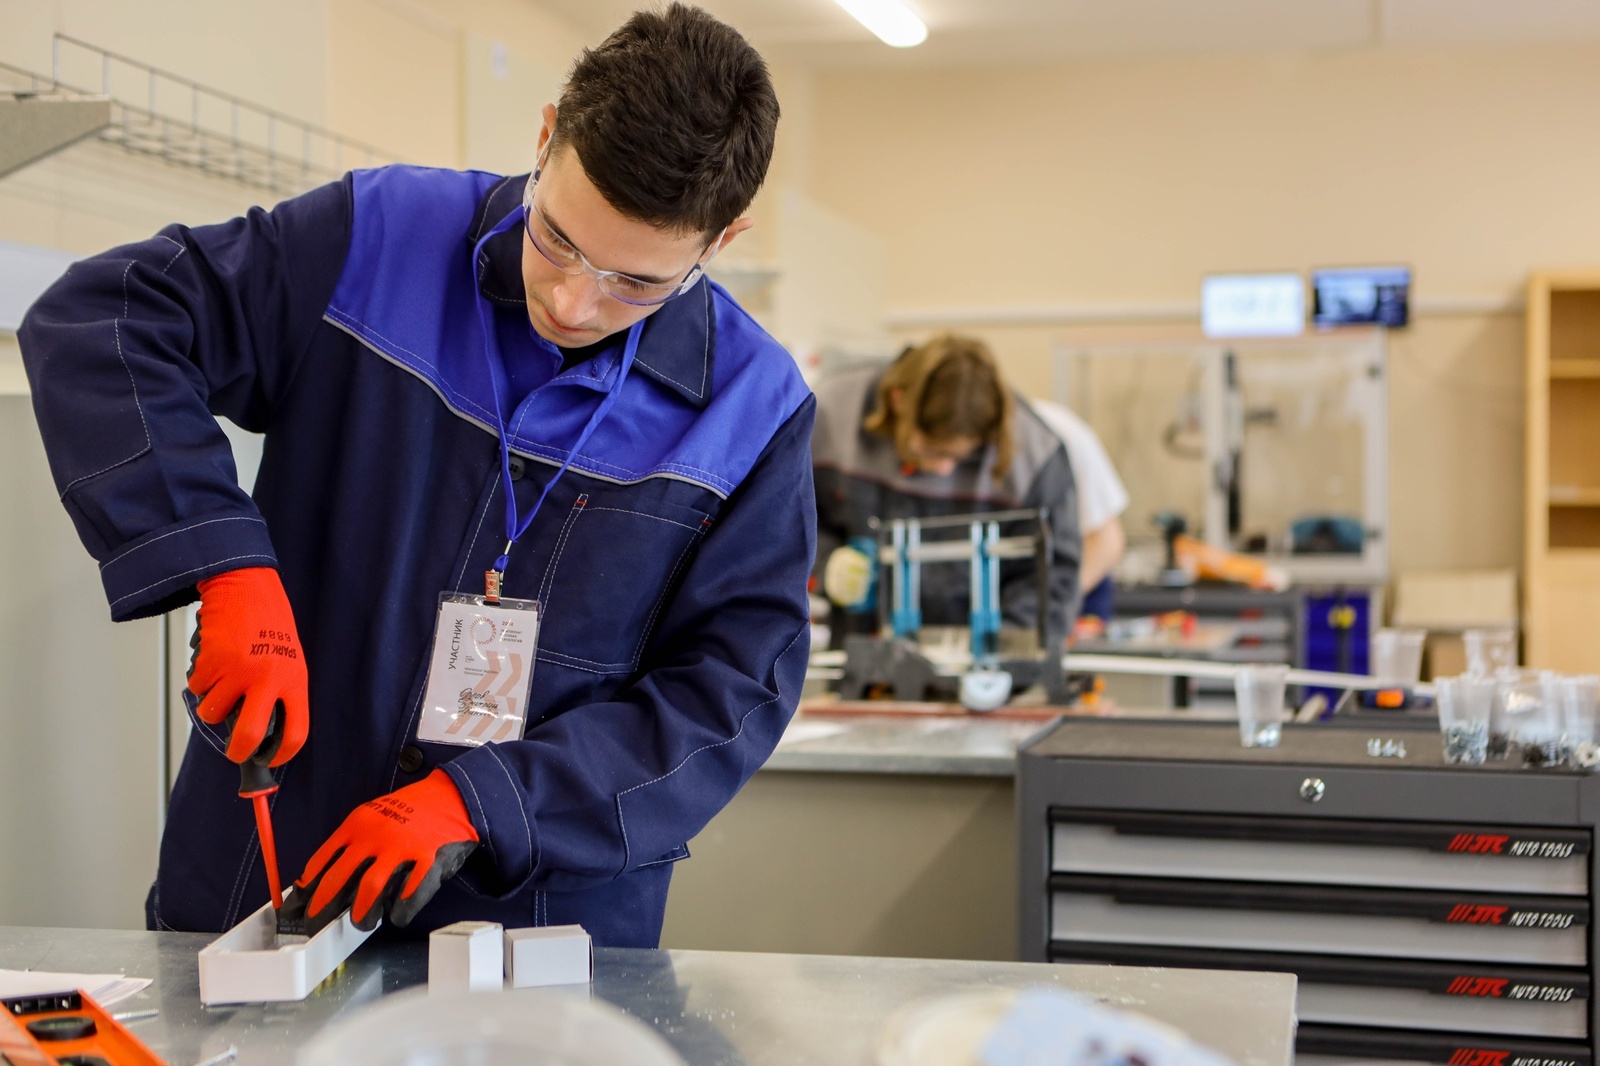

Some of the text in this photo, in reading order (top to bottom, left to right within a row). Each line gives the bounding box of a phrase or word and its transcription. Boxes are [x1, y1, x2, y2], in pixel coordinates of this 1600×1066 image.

[249, 644, 297, 659] SPARK LUX
[448, 618, 463, 670] УЧАСТНИК
[1508, 840, 1540, 856] AUTO
[1538, 842, 1575, 858] TOOLS
[1508, 912, 1540, 928] AUTO
[1538, 912, 1574, 929] TOOLS
[1508, 984, 1540, 1000] AUTO
[1538, 986, 1575, 1002] TOOLS
